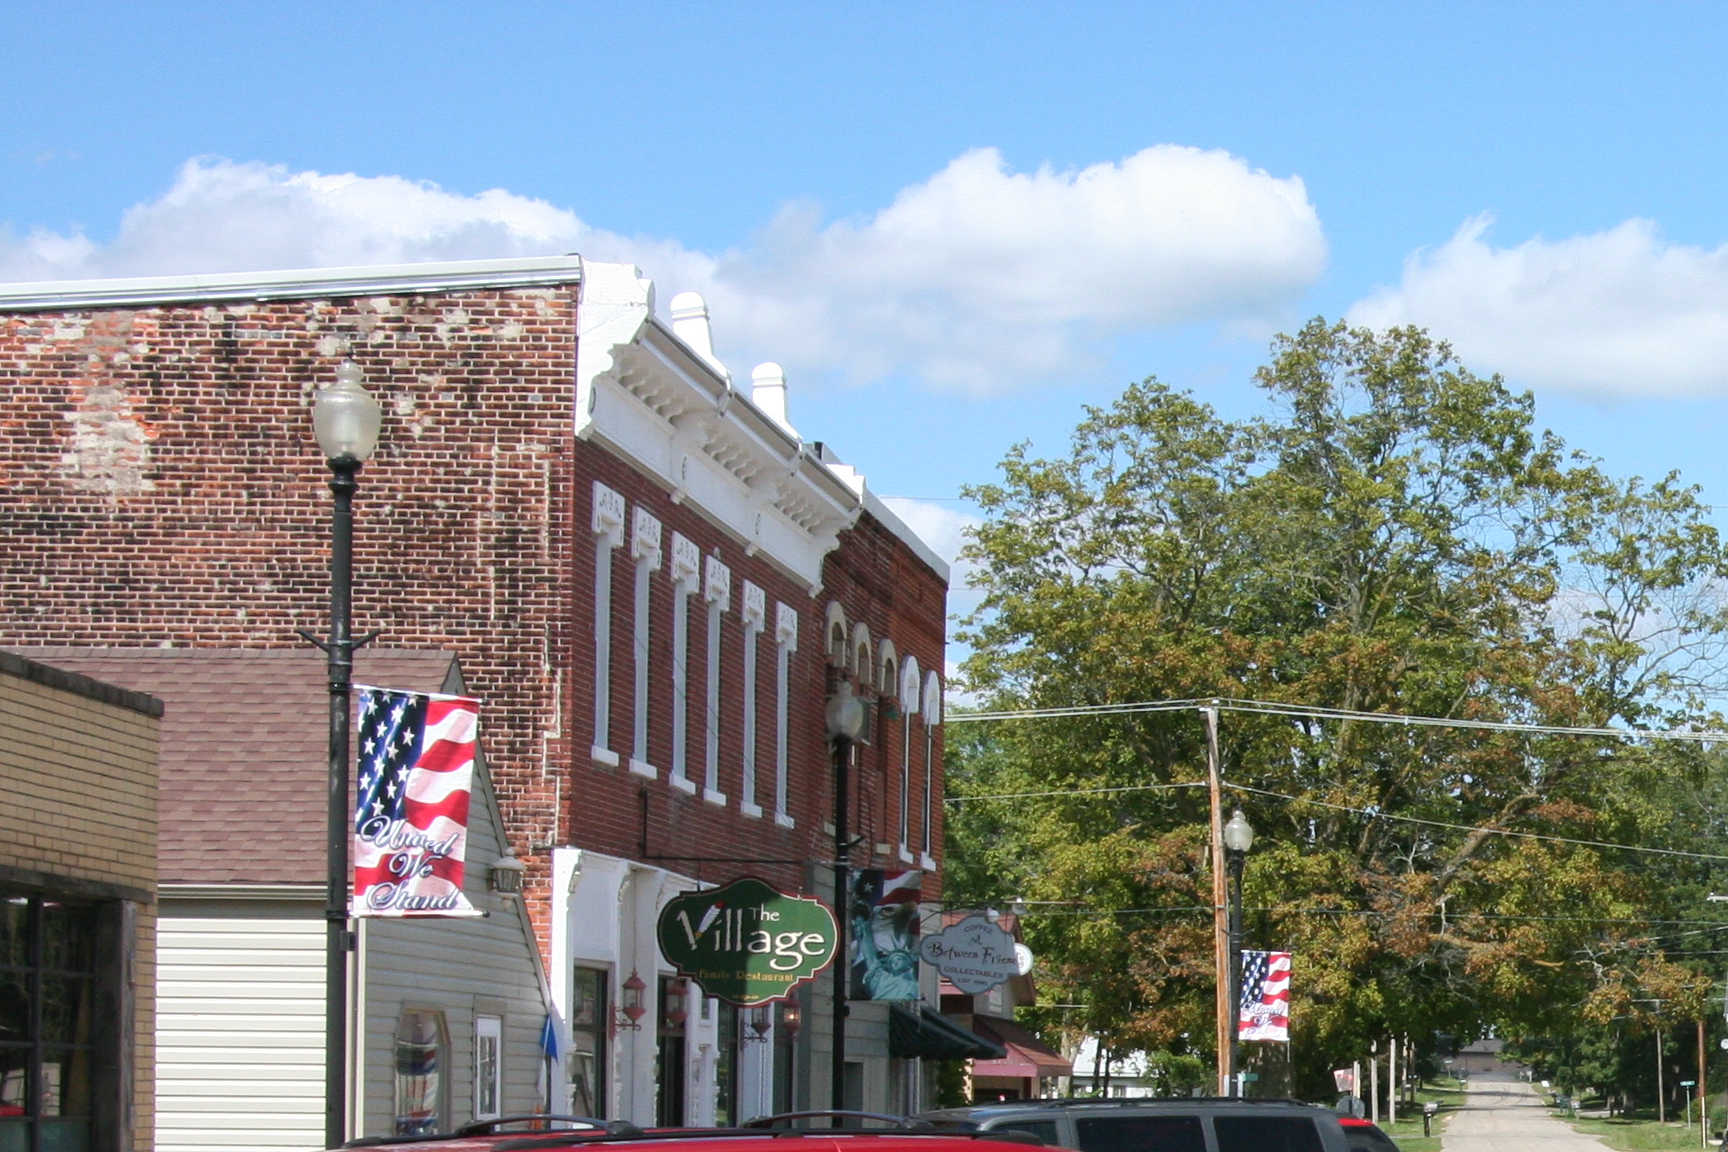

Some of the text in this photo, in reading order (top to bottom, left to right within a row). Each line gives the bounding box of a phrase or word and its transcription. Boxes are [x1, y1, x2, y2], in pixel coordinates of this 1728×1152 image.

[360, 815, 460, 855] United
[388, 852, 443, 878] We
[367, 880, 460, 910] Stand
[748, 903, 781, 922] The
[676, 905, 826, 971] Village
[964, 924, 995, 934] COFFEE
[926, 941, 979, 960] Between
[736, 970, 794, 983] Restaurant
[944, 965, 1004, 979] COLLECTABLES
